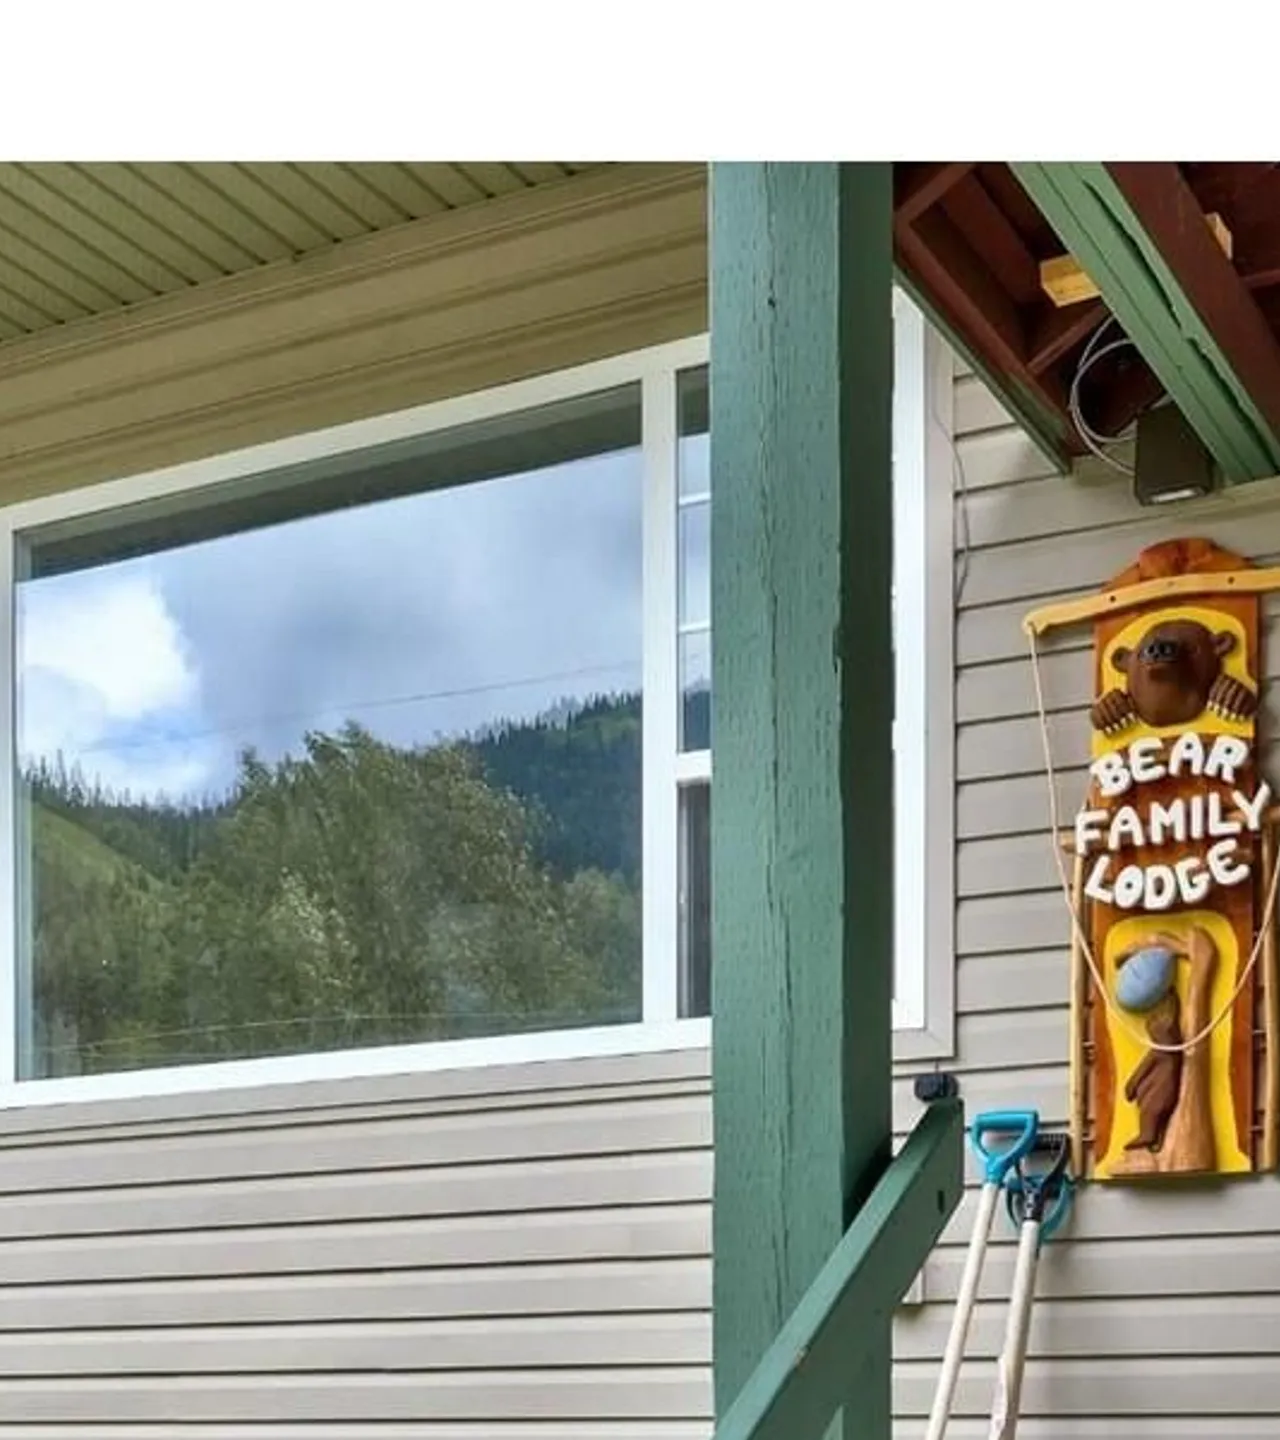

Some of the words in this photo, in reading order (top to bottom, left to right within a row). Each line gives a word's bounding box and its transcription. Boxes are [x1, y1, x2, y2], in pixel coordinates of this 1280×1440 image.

[1090, 731, 1248, 796] BEAR
[1075, 781, 1269, 856] FAMILY
[1084, 839, 1250, 910] LODGE
